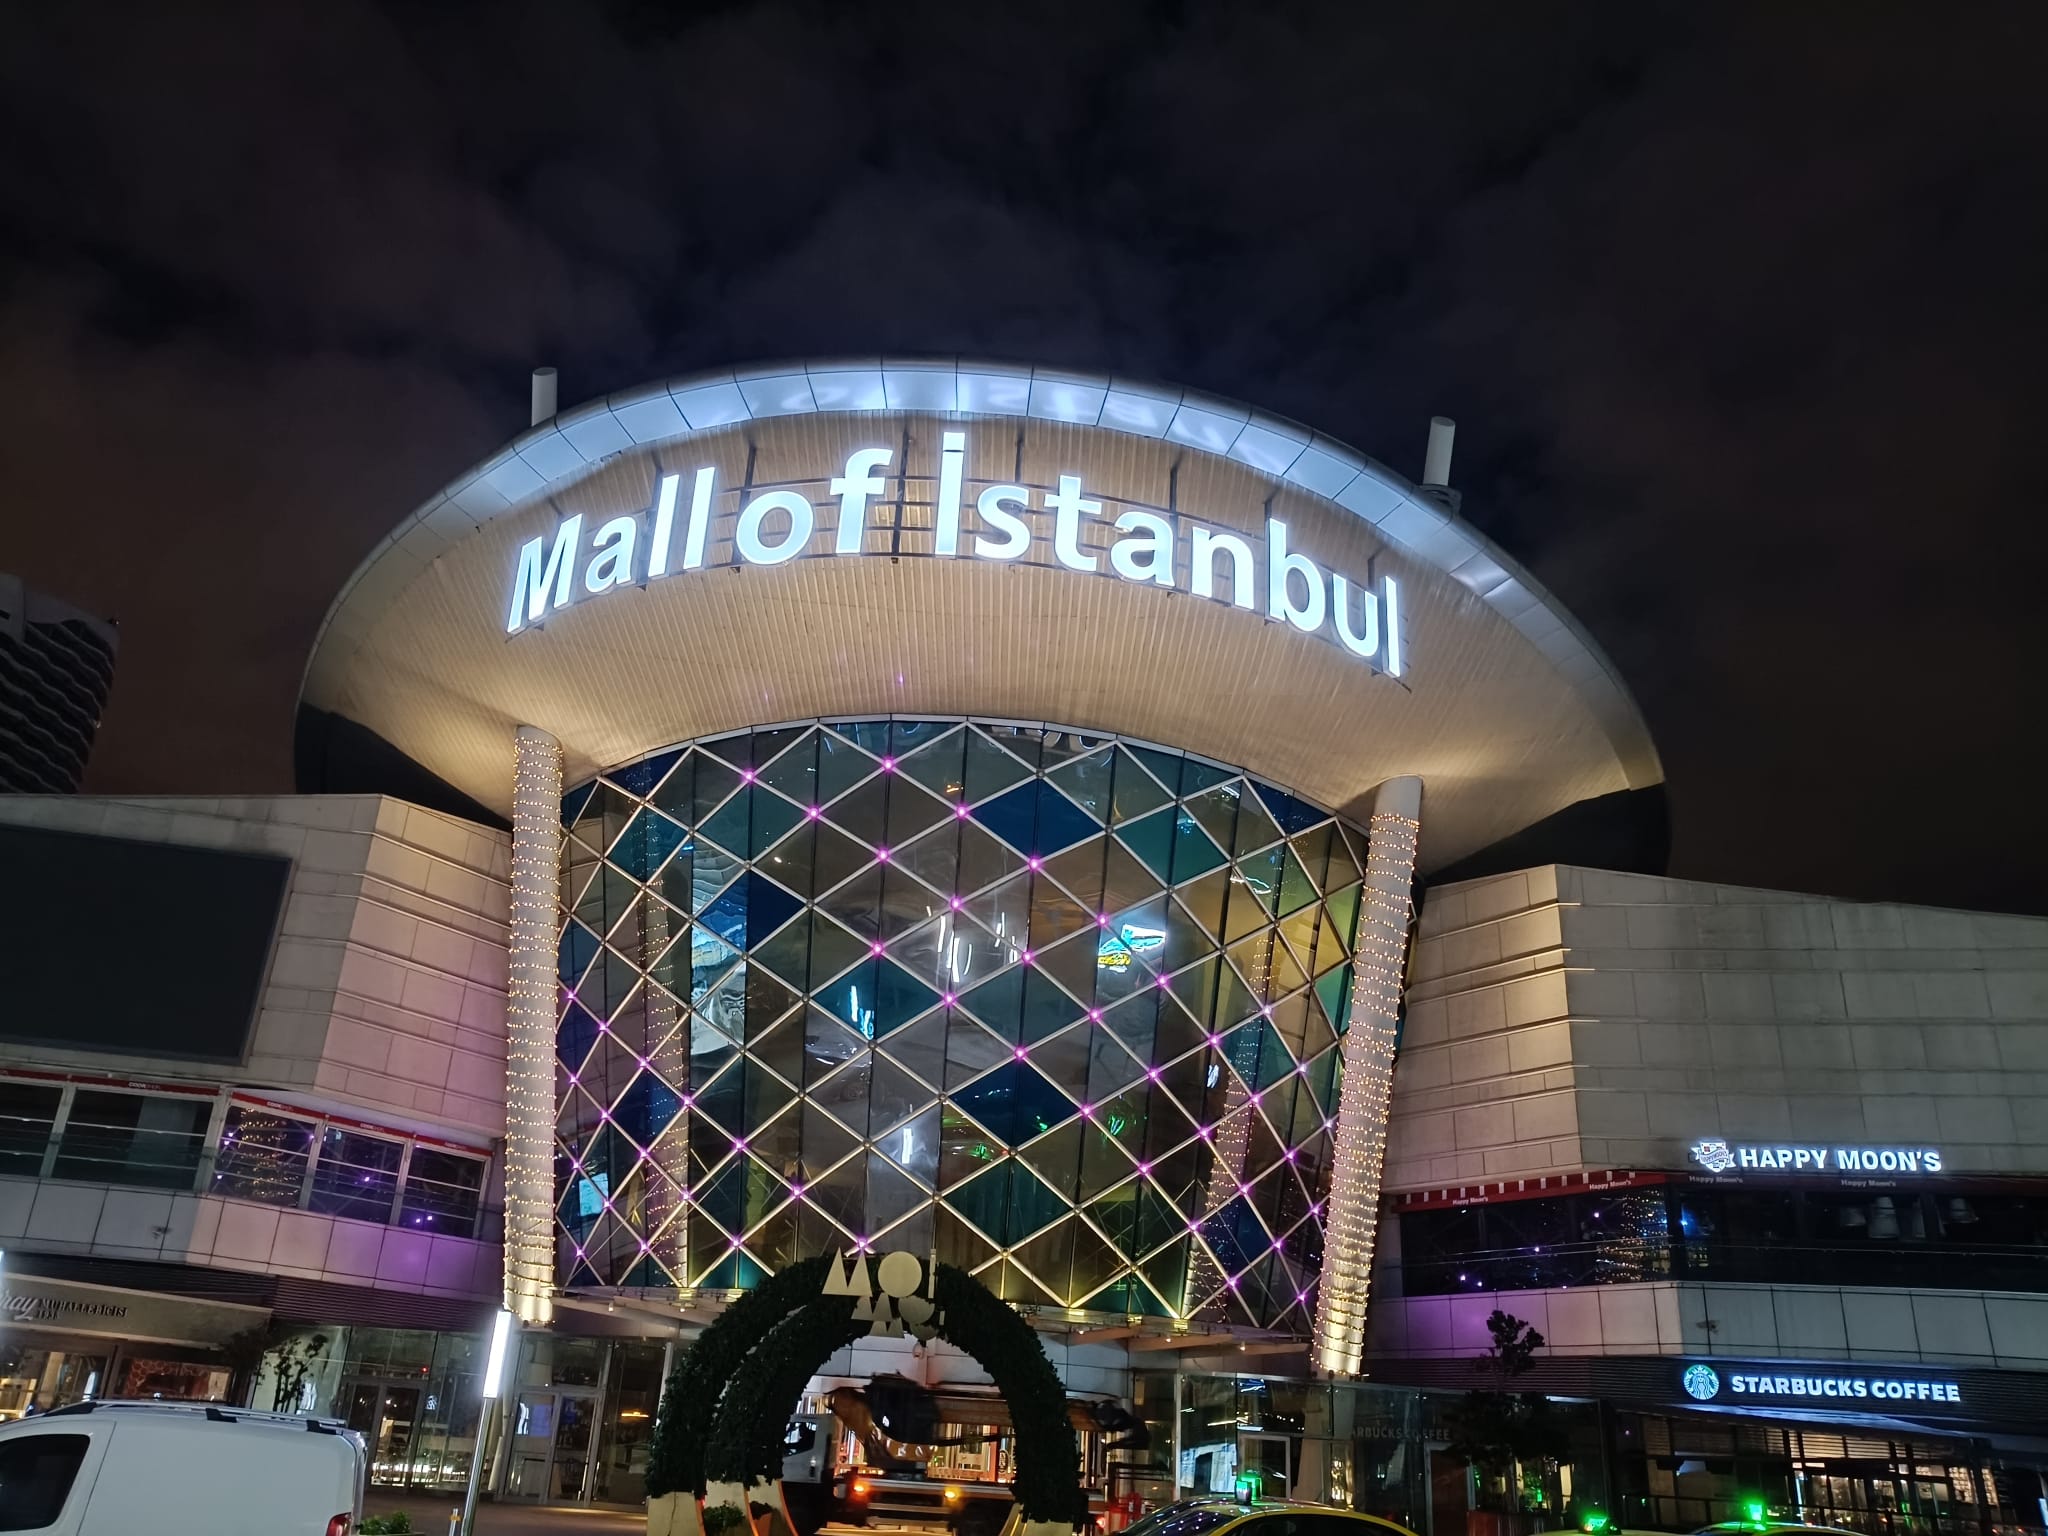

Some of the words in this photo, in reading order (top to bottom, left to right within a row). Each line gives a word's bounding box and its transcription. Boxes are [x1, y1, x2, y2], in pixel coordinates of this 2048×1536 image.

[506, 465, 716, 637] Mall
[734, 447, 893, 566] of
[1739, 1148, 1828, 1169] HAPPY
[1838, 1150, 1942, 1172] MOON'S
[1731, 1375, 1867, 1398] STARBUCKS
[1871, 1381, 1961, 1402] COFFEE
